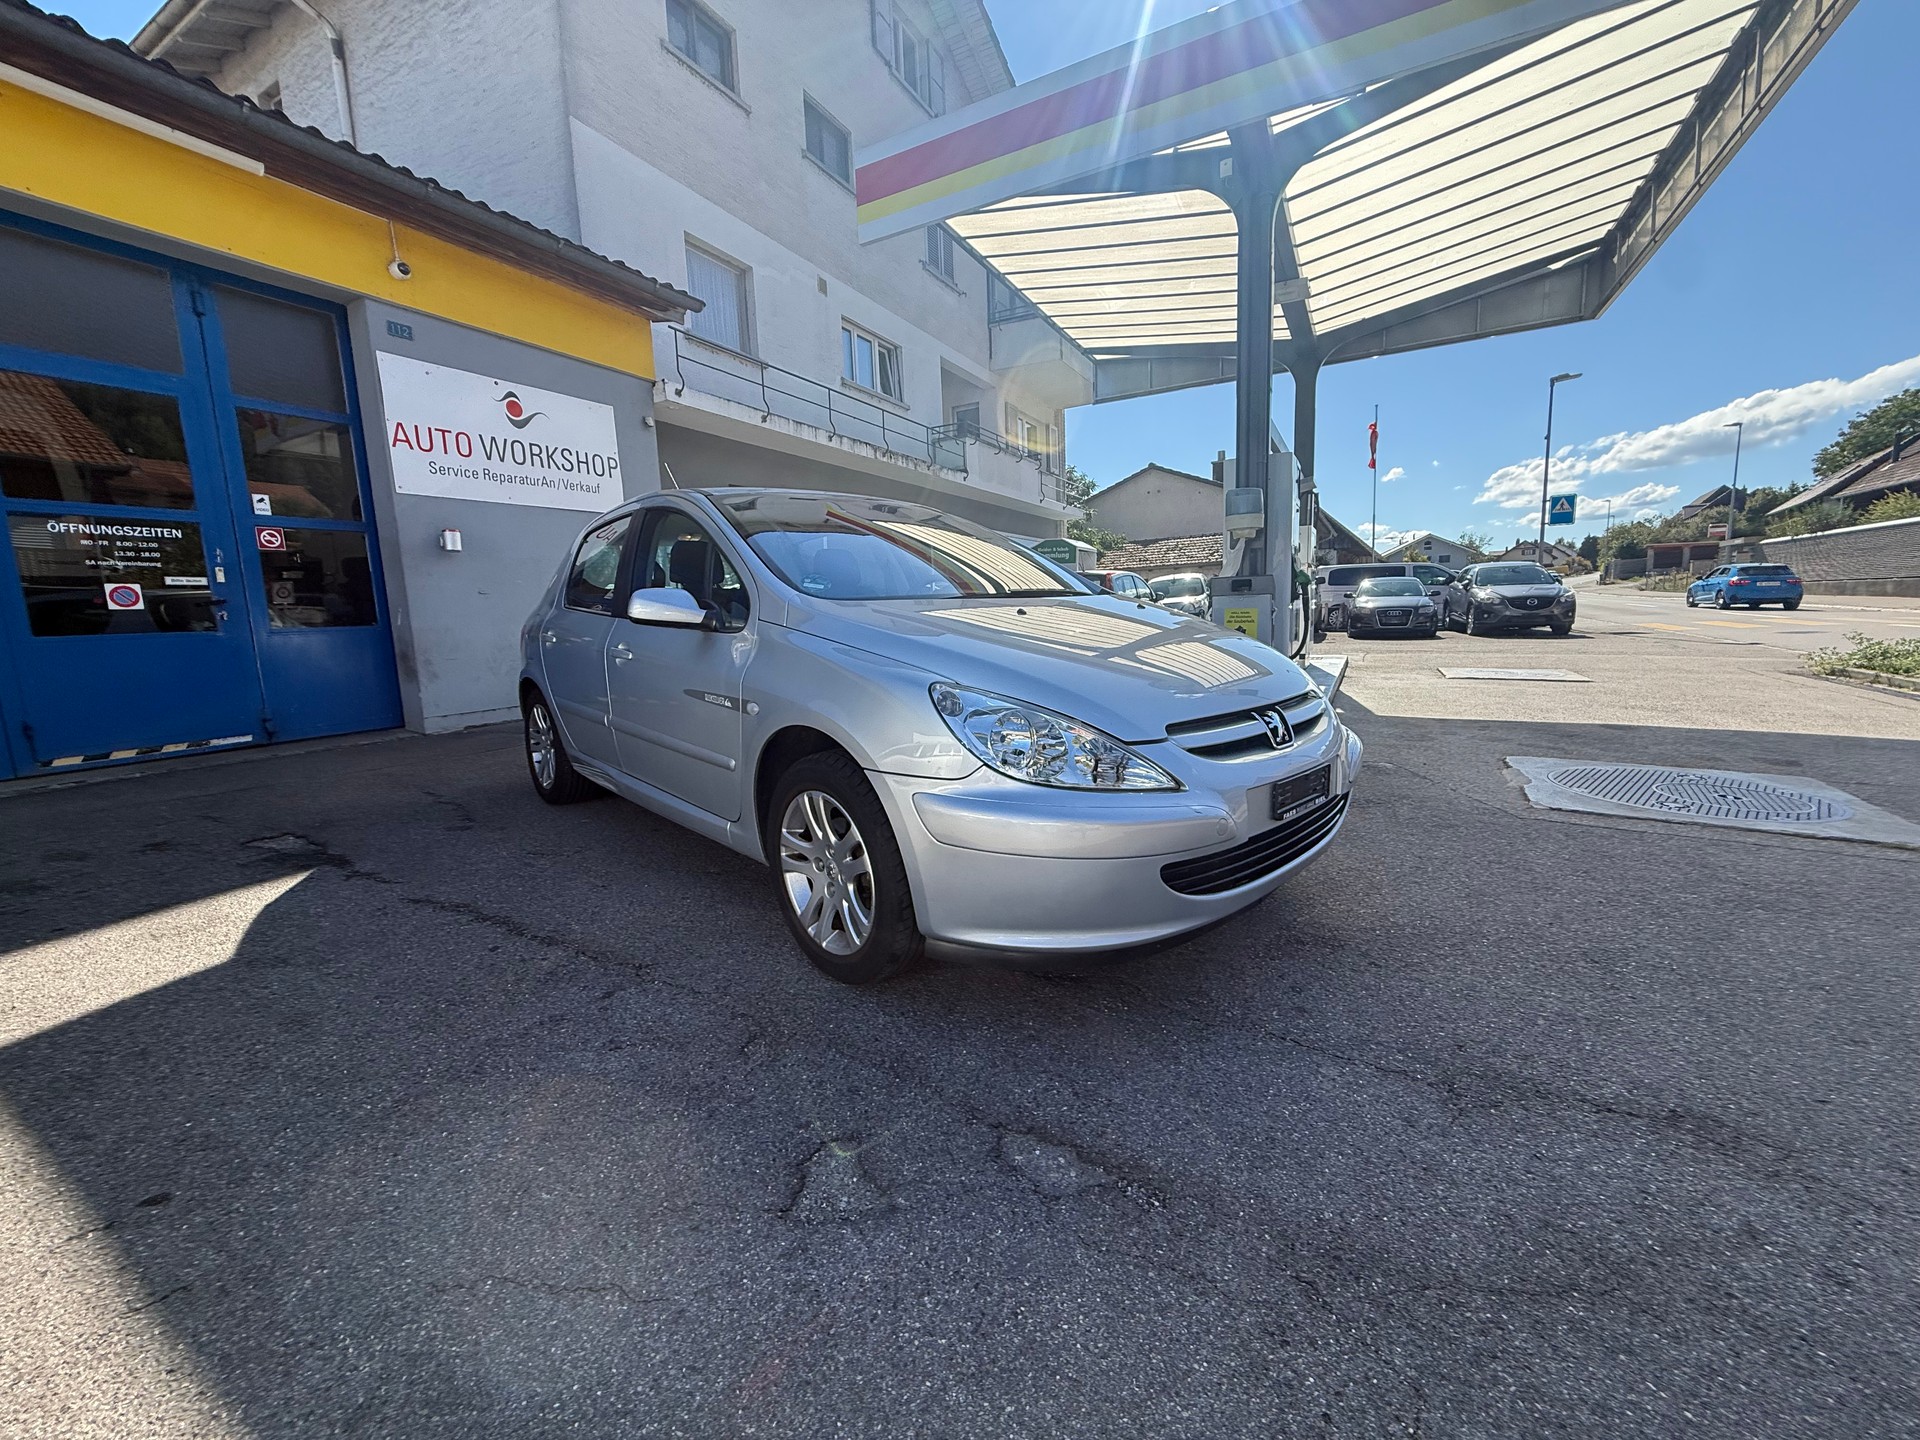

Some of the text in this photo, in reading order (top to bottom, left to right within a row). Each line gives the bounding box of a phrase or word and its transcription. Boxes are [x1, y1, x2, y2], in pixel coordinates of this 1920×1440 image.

[389, 322, 409, 337] 112
[392, 422, 618, 479] AUTO WORKSHOP
[428, 461, 479, 480] Service
[47, 520, 183, 539] ÖFFNUNGSZEITEN
